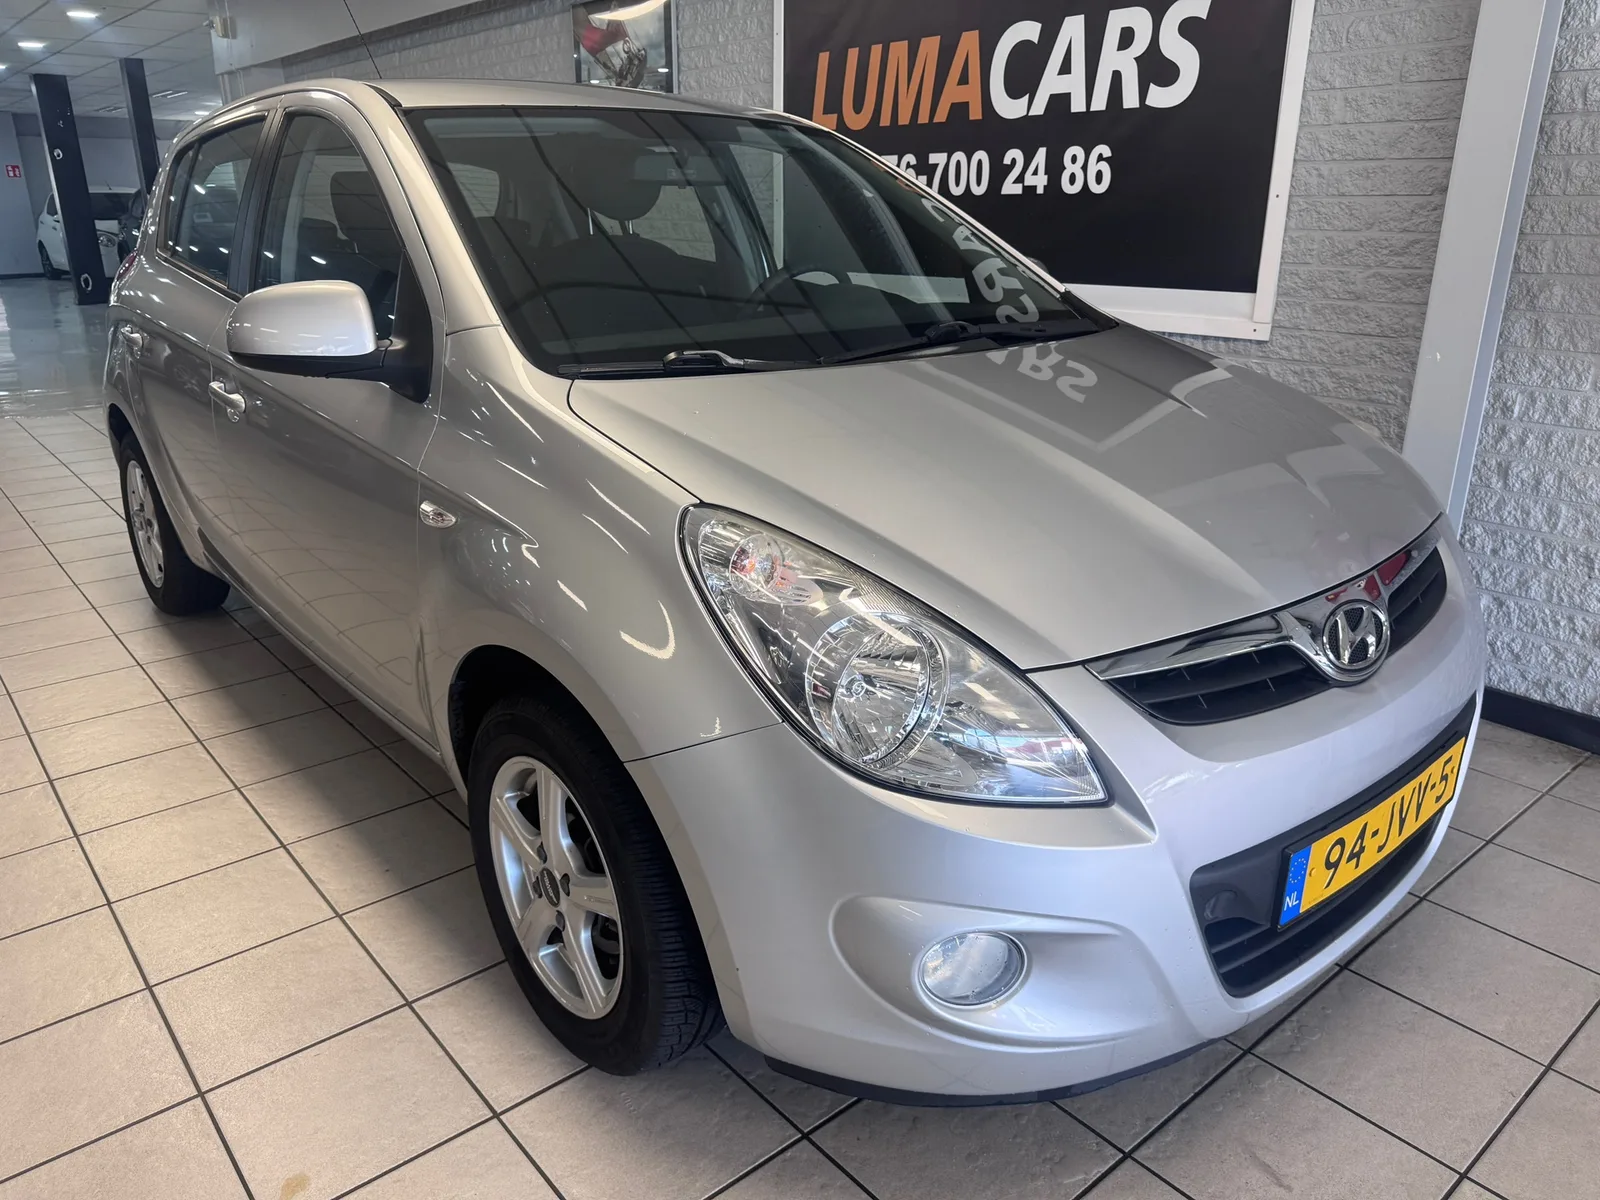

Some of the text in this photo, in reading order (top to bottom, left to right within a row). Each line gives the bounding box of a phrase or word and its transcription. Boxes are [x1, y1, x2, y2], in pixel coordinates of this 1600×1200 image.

[1001, 146, 1048, 195] 24
[1061, 144, 1112, 194] 86
[1324, 754, 1453, 890] 94-JVV-5
[1284, 891, 1300, 911] NL
